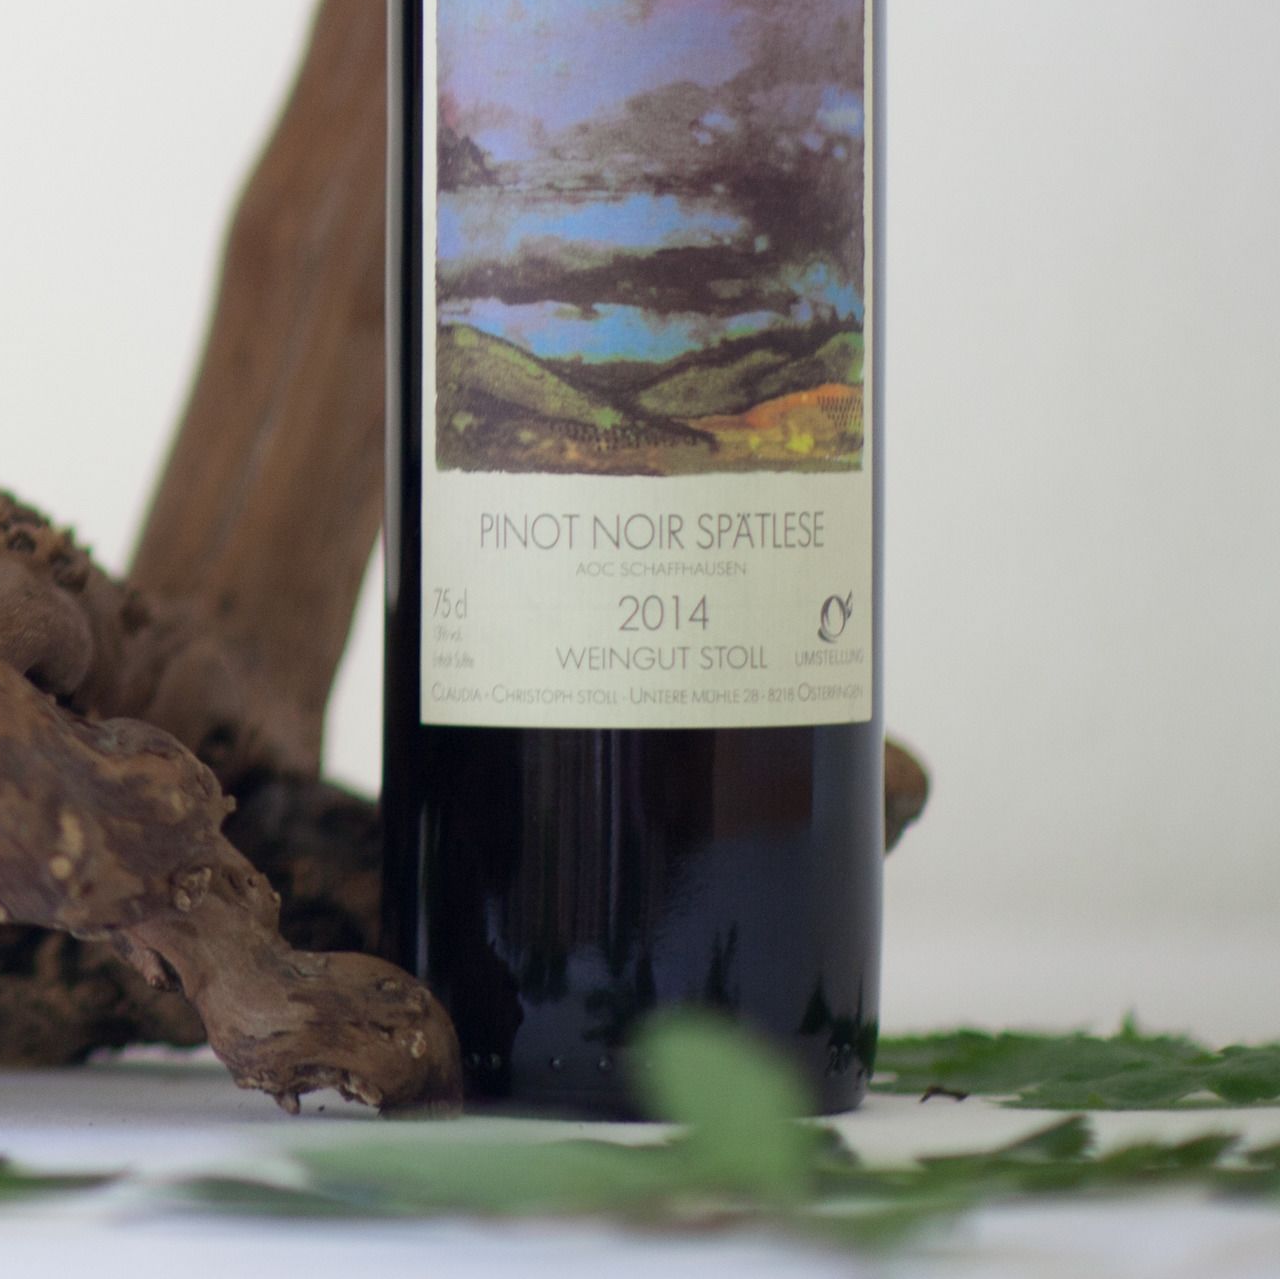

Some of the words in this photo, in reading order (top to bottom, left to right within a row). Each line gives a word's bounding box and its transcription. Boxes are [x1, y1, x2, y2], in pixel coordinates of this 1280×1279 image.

[480, 512, 581, 551] PINOT
[593, 513, 685, 551] NOIR
[695, 511, 825, 550] SPÄTLESE
[575, 561, 615, 577] AOC
[619, 560, 748, 577] SCHAFFHAUSEN
[432, 587, 452, 619] 75
[617, 594, 710, 631] 2014
[555, 645, 691, 670] WEINGUT
[699, 645, 769, 670] STOLL
[743, 687, 760, 704] 28
